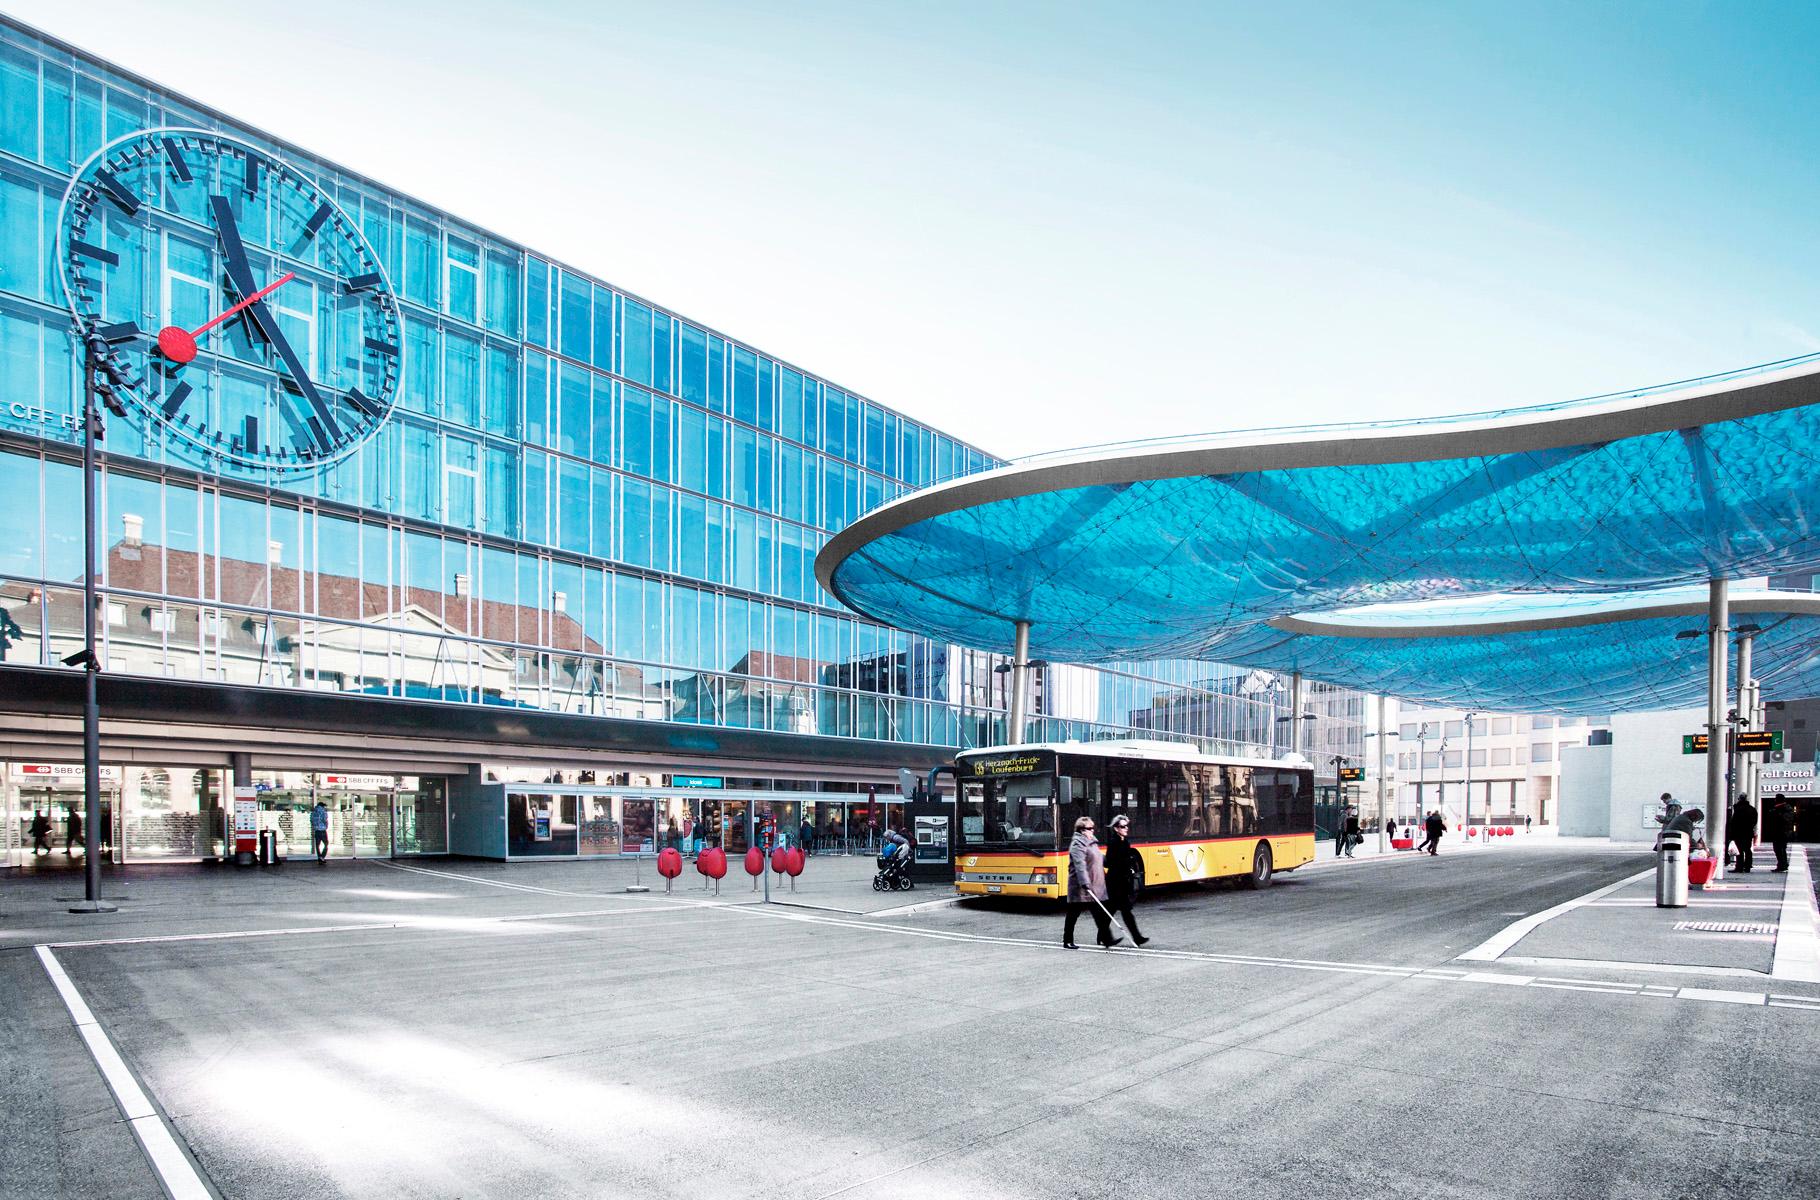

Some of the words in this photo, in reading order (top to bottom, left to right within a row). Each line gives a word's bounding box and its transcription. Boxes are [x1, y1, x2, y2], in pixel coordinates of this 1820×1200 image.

[10, 402, 54, 423] CFF
[61, 413, 87, 431] FF
[1761, 769, 1780, 778] rell
[1783, 769, 1813, 778] Hotel
[1762, 782, 1813, 792] uerhof
